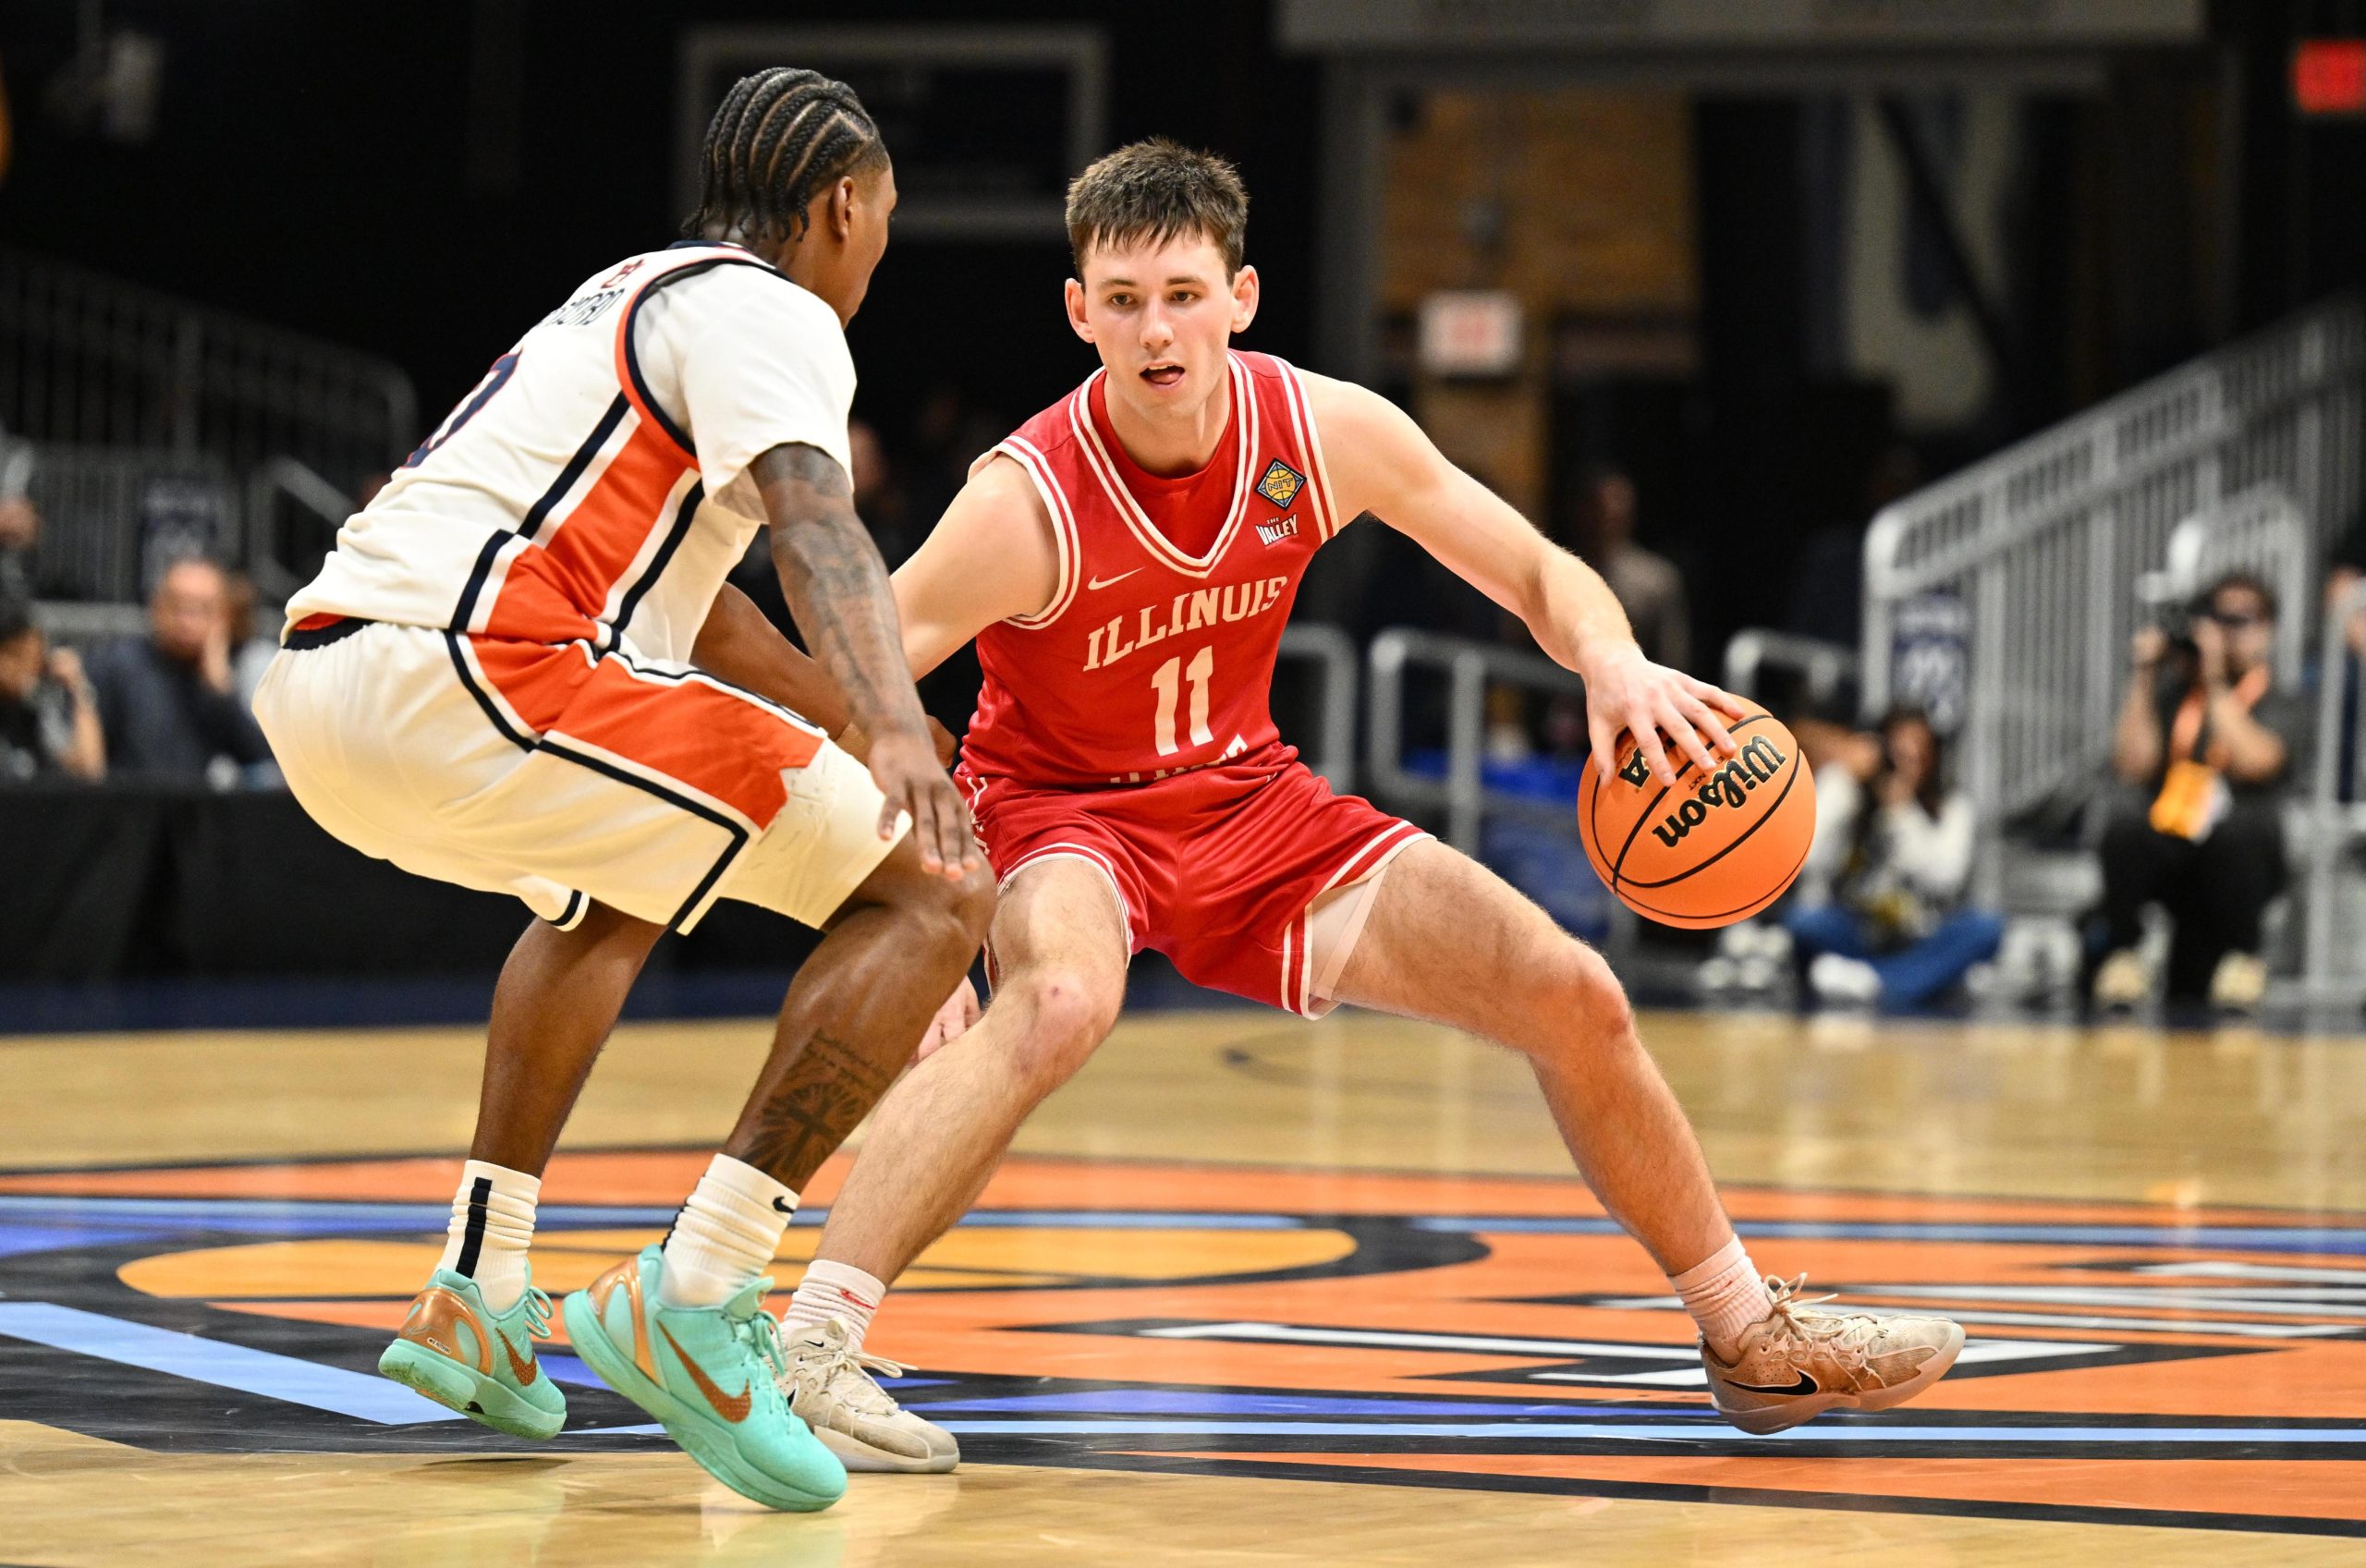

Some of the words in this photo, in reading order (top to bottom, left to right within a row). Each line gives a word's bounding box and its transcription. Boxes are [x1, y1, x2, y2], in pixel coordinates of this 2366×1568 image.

[1268, 478, 1293, 492] NIT
[1255, 514, 1298, 546] VALLEY
[1151, 645, 1213, 757] 11
[1652, 735, 1787, 847] Wilson
